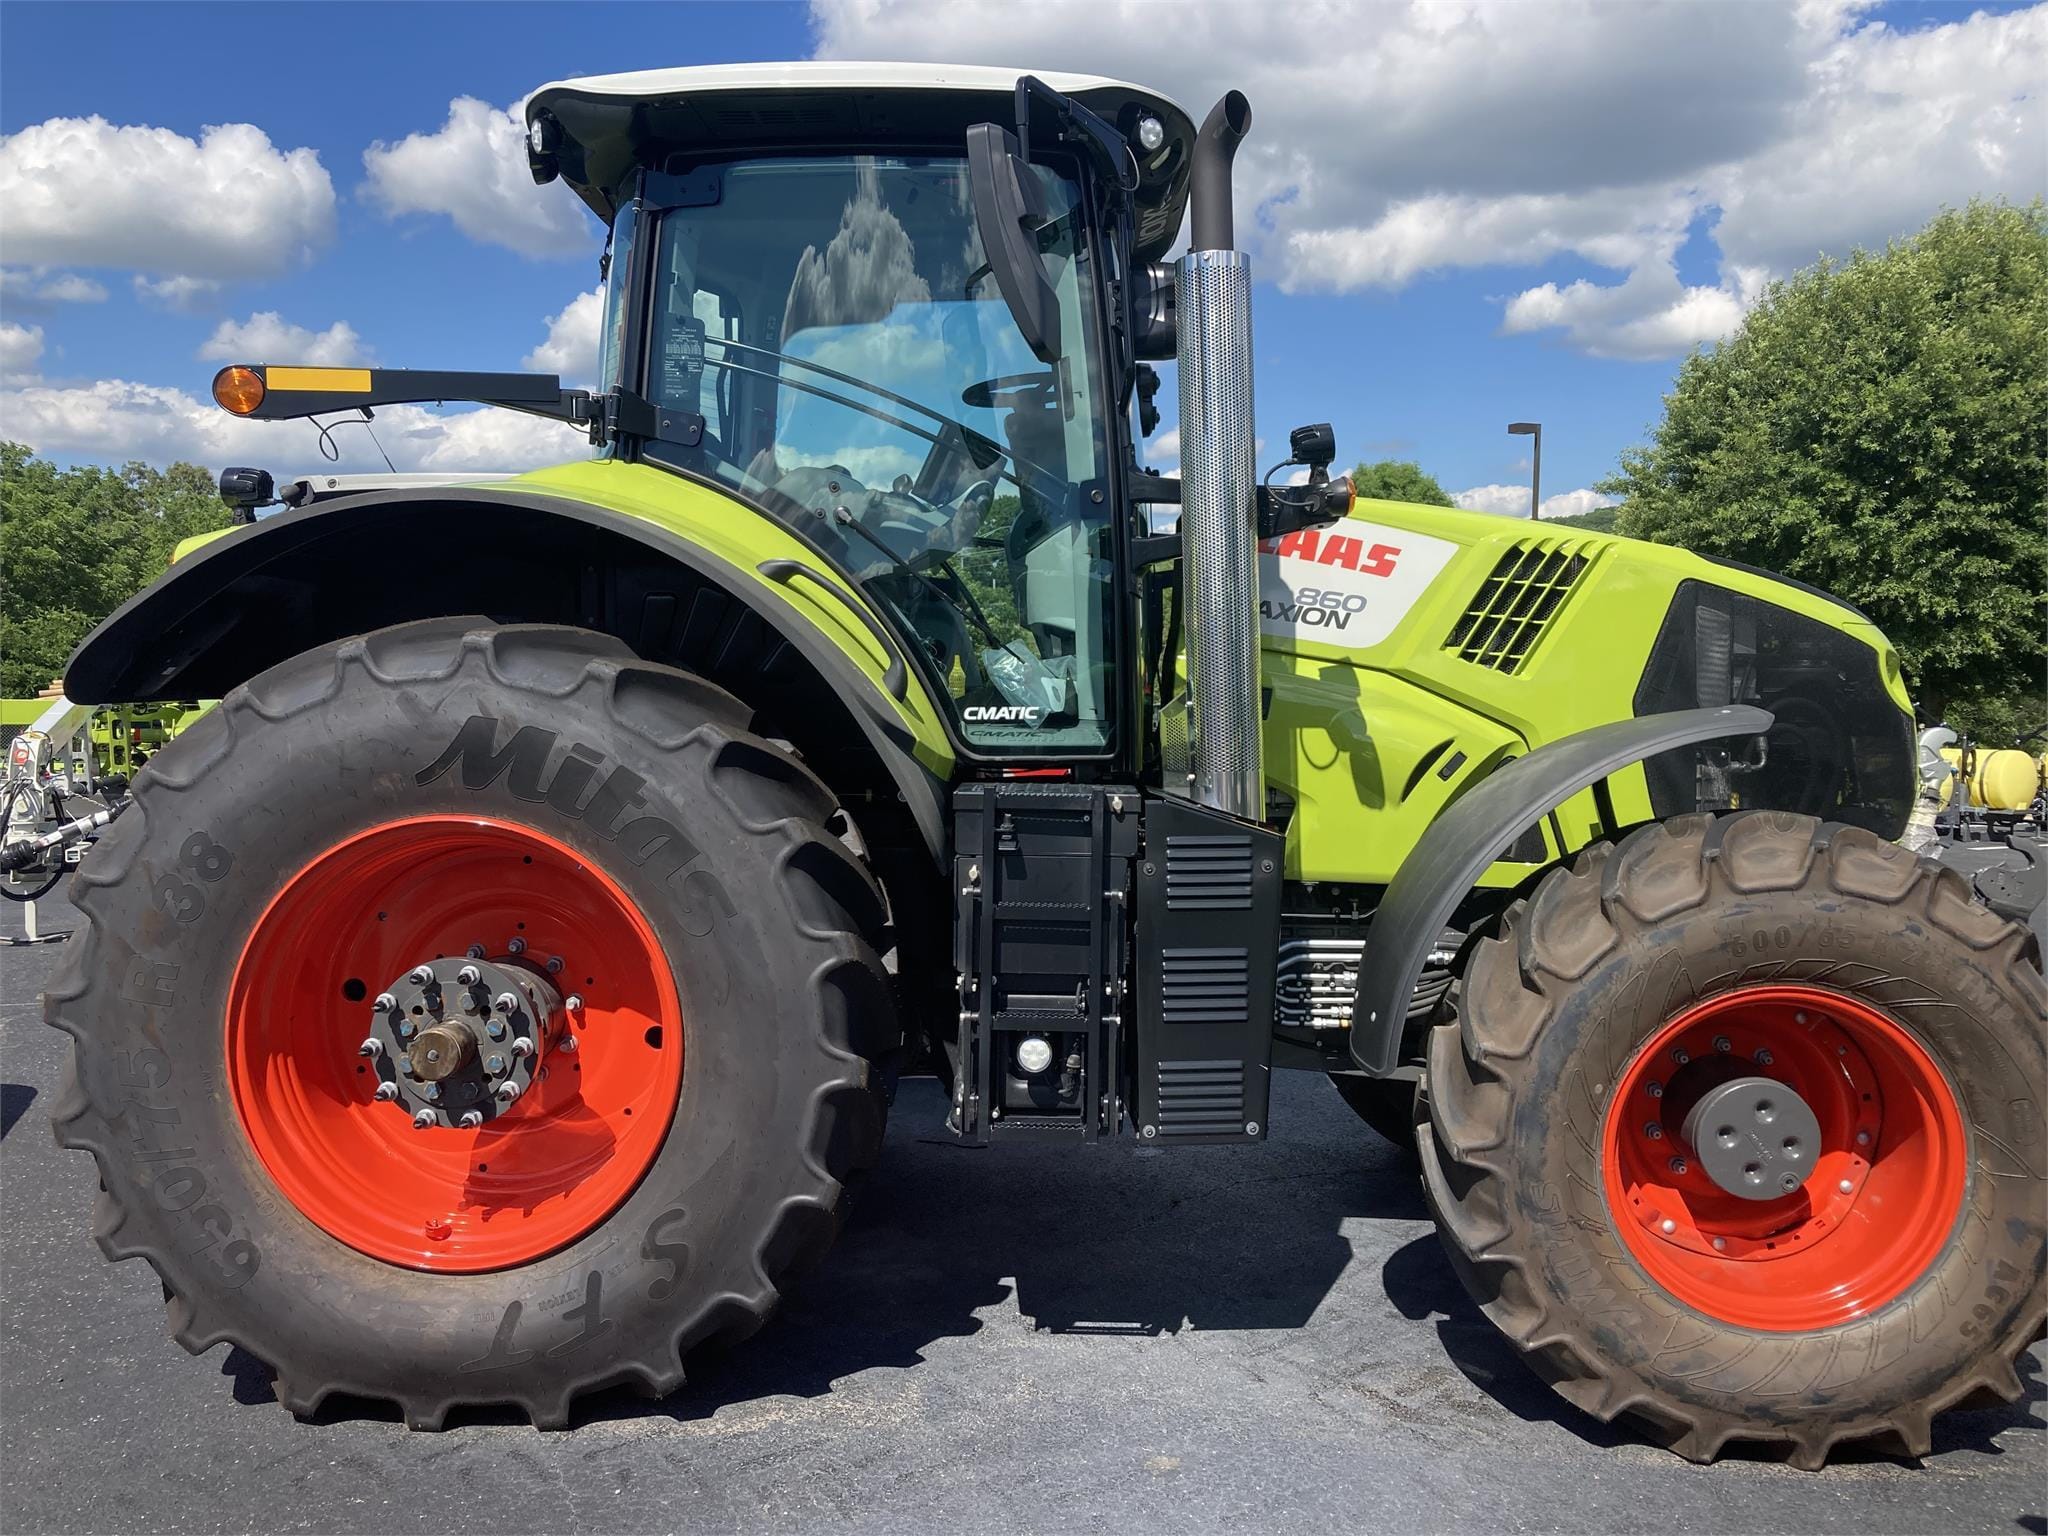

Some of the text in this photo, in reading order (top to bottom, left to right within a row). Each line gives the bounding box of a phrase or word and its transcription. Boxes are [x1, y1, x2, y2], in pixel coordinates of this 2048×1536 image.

[1296, 587, 1368, 613] 860
[1260, 600, 1352, 630] AXION
[963, 706, 1040, 721] CMATIC
[414, 715, 739, 938] Mitas
